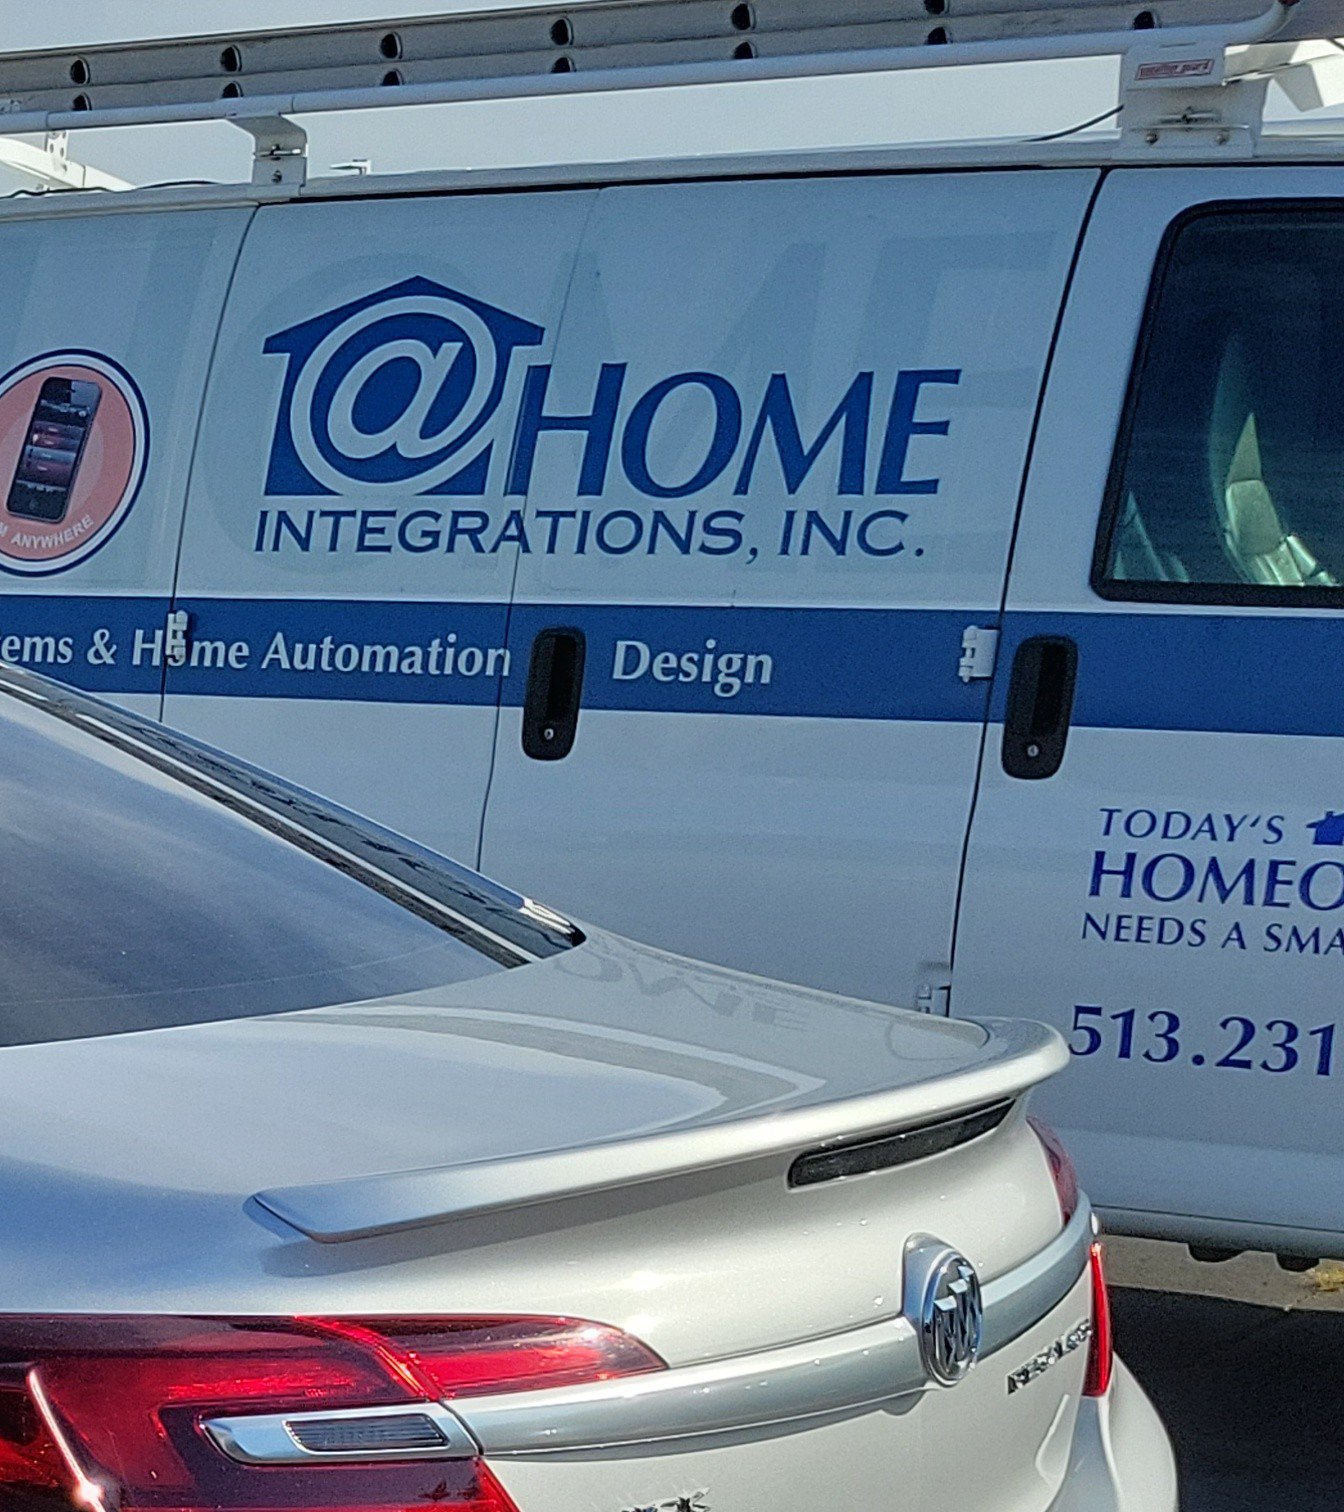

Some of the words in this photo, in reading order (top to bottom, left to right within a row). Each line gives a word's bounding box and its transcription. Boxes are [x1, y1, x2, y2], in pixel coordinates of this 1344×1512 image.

[290, 294, 962, 499] @HOME
[11, 515, 95, 550] ANYWHERE
[253, 509, 758, 565] INTEGRATIONS,
[779, 508, 925, 558] INC.
[86, 627, 116, 664] &
[261, 631, 512, 678] Automation
[612, 638, 774, 698] Design
[1099, 807, 1285, 845] TODAY'S
[1081, 912, 1207, 948] NEEDS
[1221, 921, 1247, 950] A
[1068, 1004, 1337, 1077] 513.231
